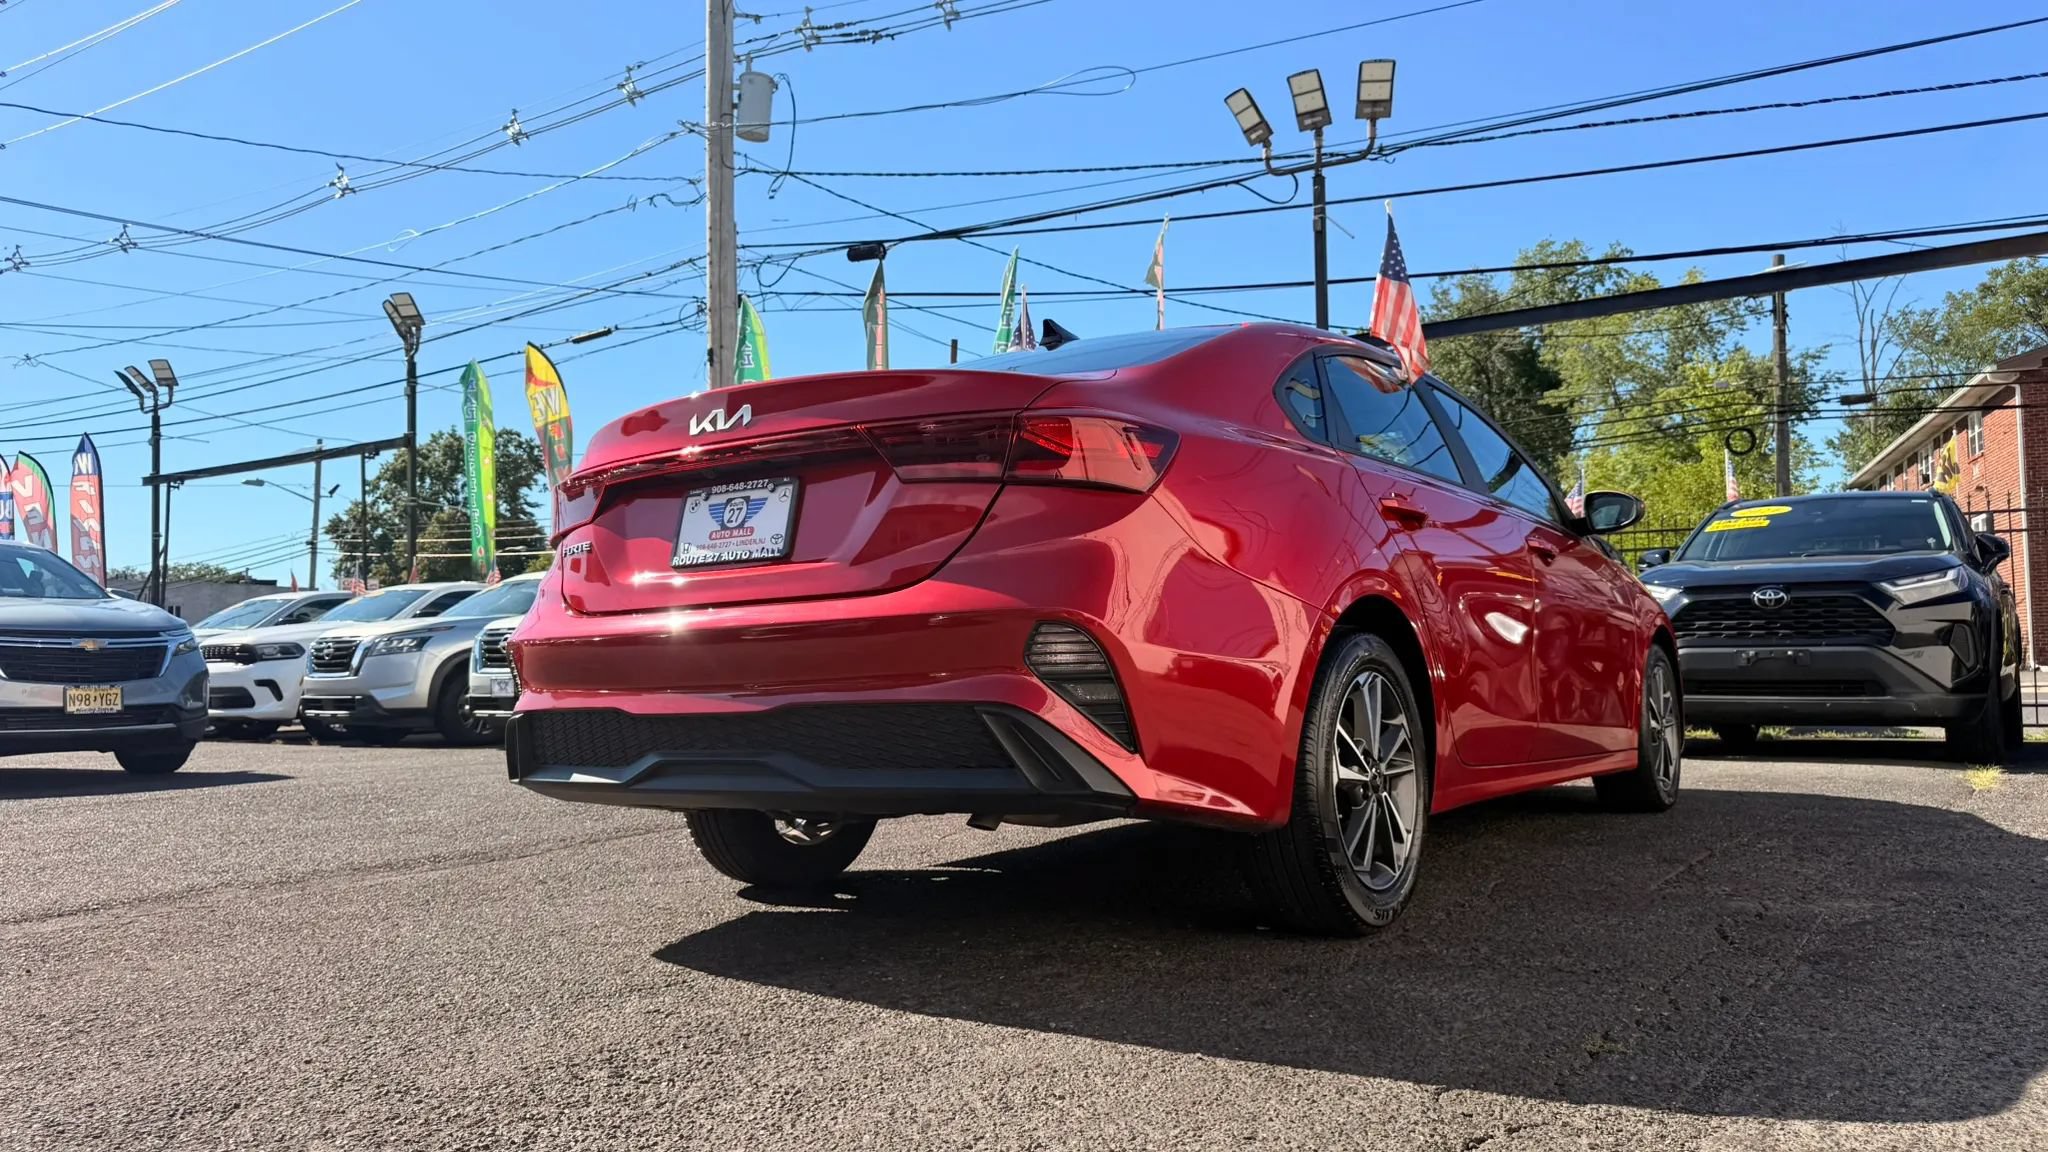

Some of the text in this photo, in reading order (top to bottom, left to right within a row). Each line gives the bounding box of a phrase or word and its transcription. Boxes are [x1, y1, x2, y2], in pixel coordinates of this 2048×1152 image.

[689, 404, 752, 435] KIA
[726, 507, 744, 524] 27
[711, 528, 753, 540] AUTO MALL
[672, 547, 781, 566] ROUTE 27 AUTO MALL
[69, 692, 119, 707] N98 YGZ
